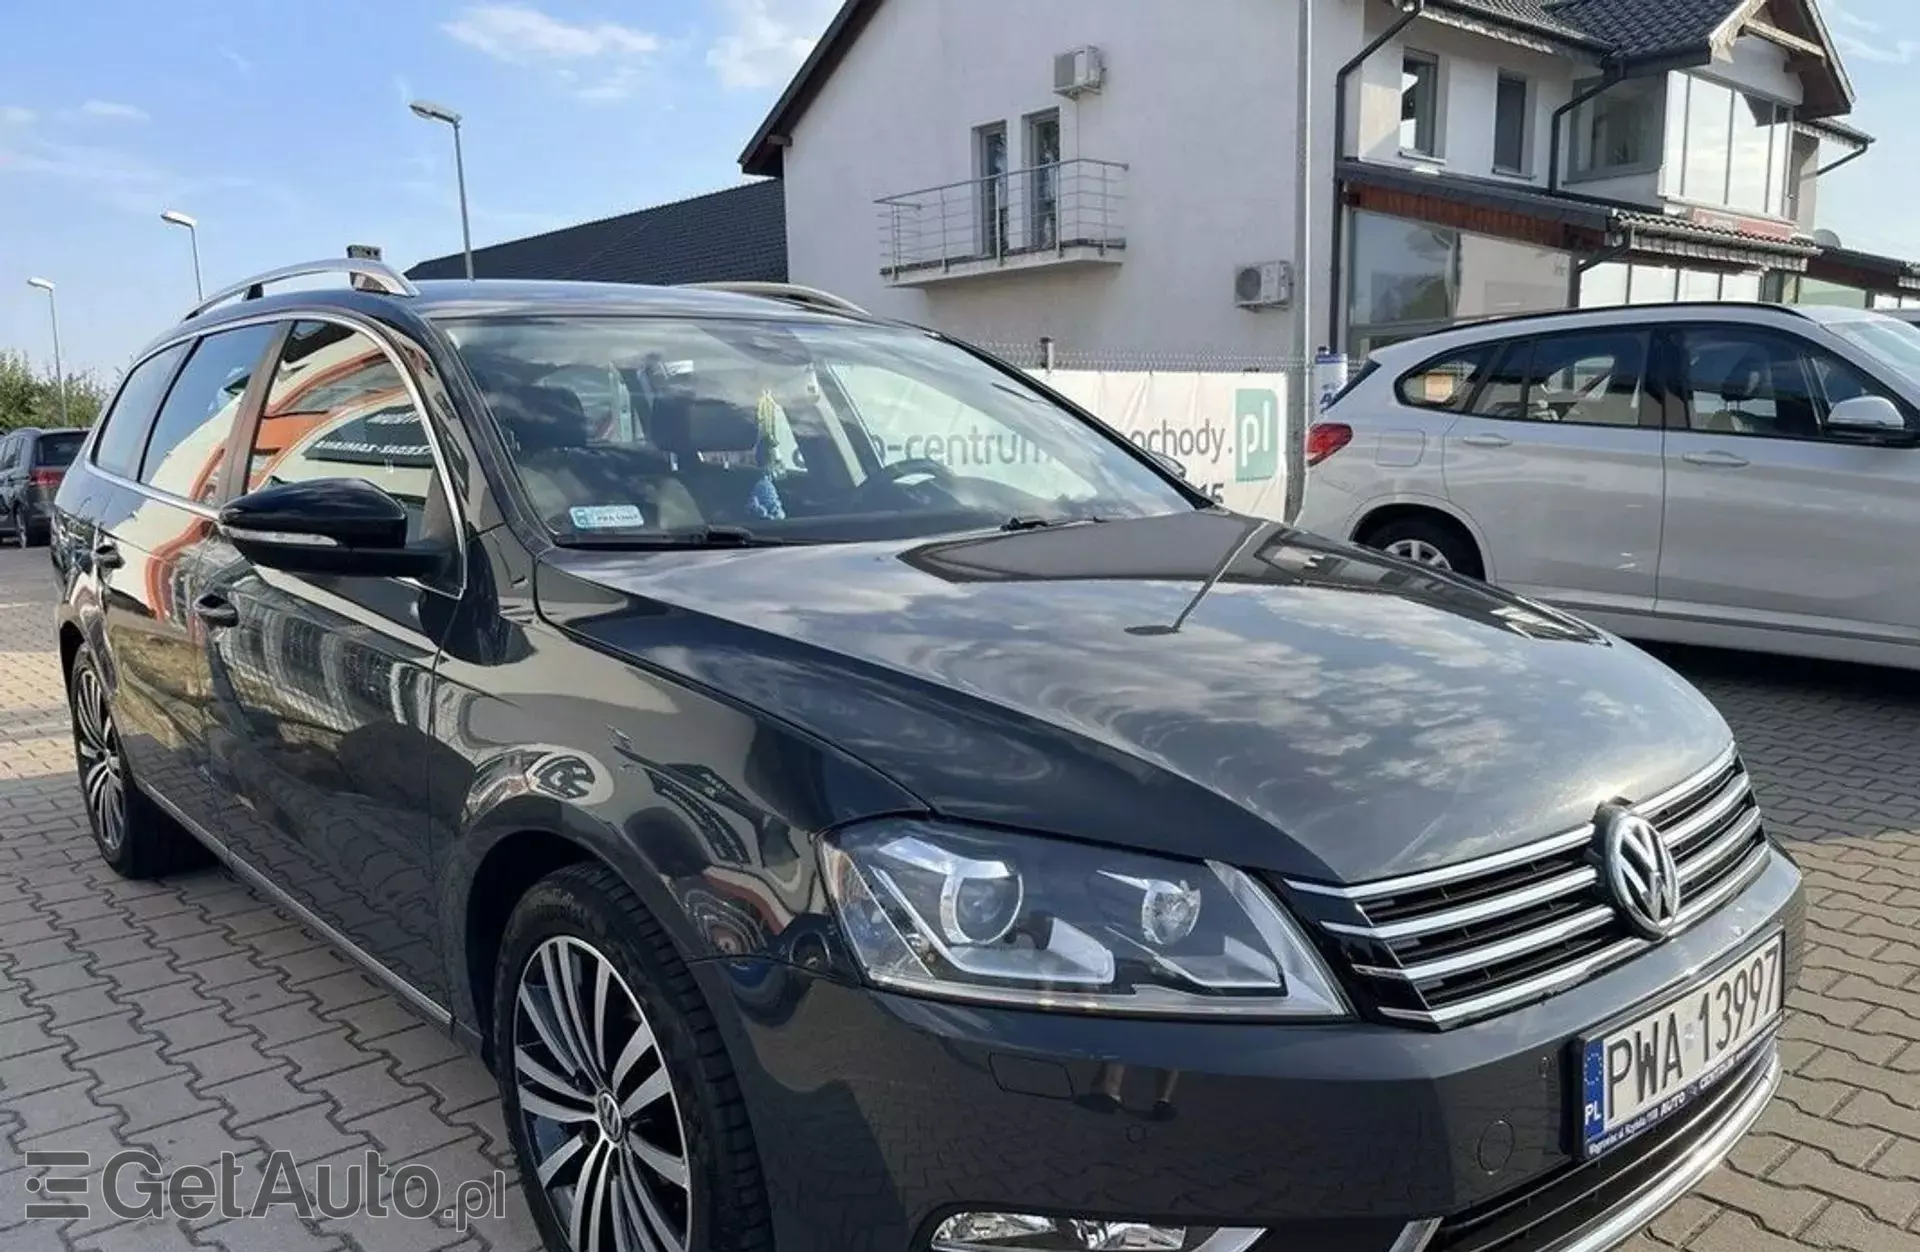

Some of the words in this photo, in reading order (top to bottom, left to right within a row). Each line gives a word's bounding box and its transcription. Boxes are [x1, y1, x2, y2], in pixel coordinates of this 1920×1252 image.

[1608, 1011, 1683, 1119] PWA
[1699, 944, 1779, 1063] 13997
[1585, 1100, 1601, 1125] PL
